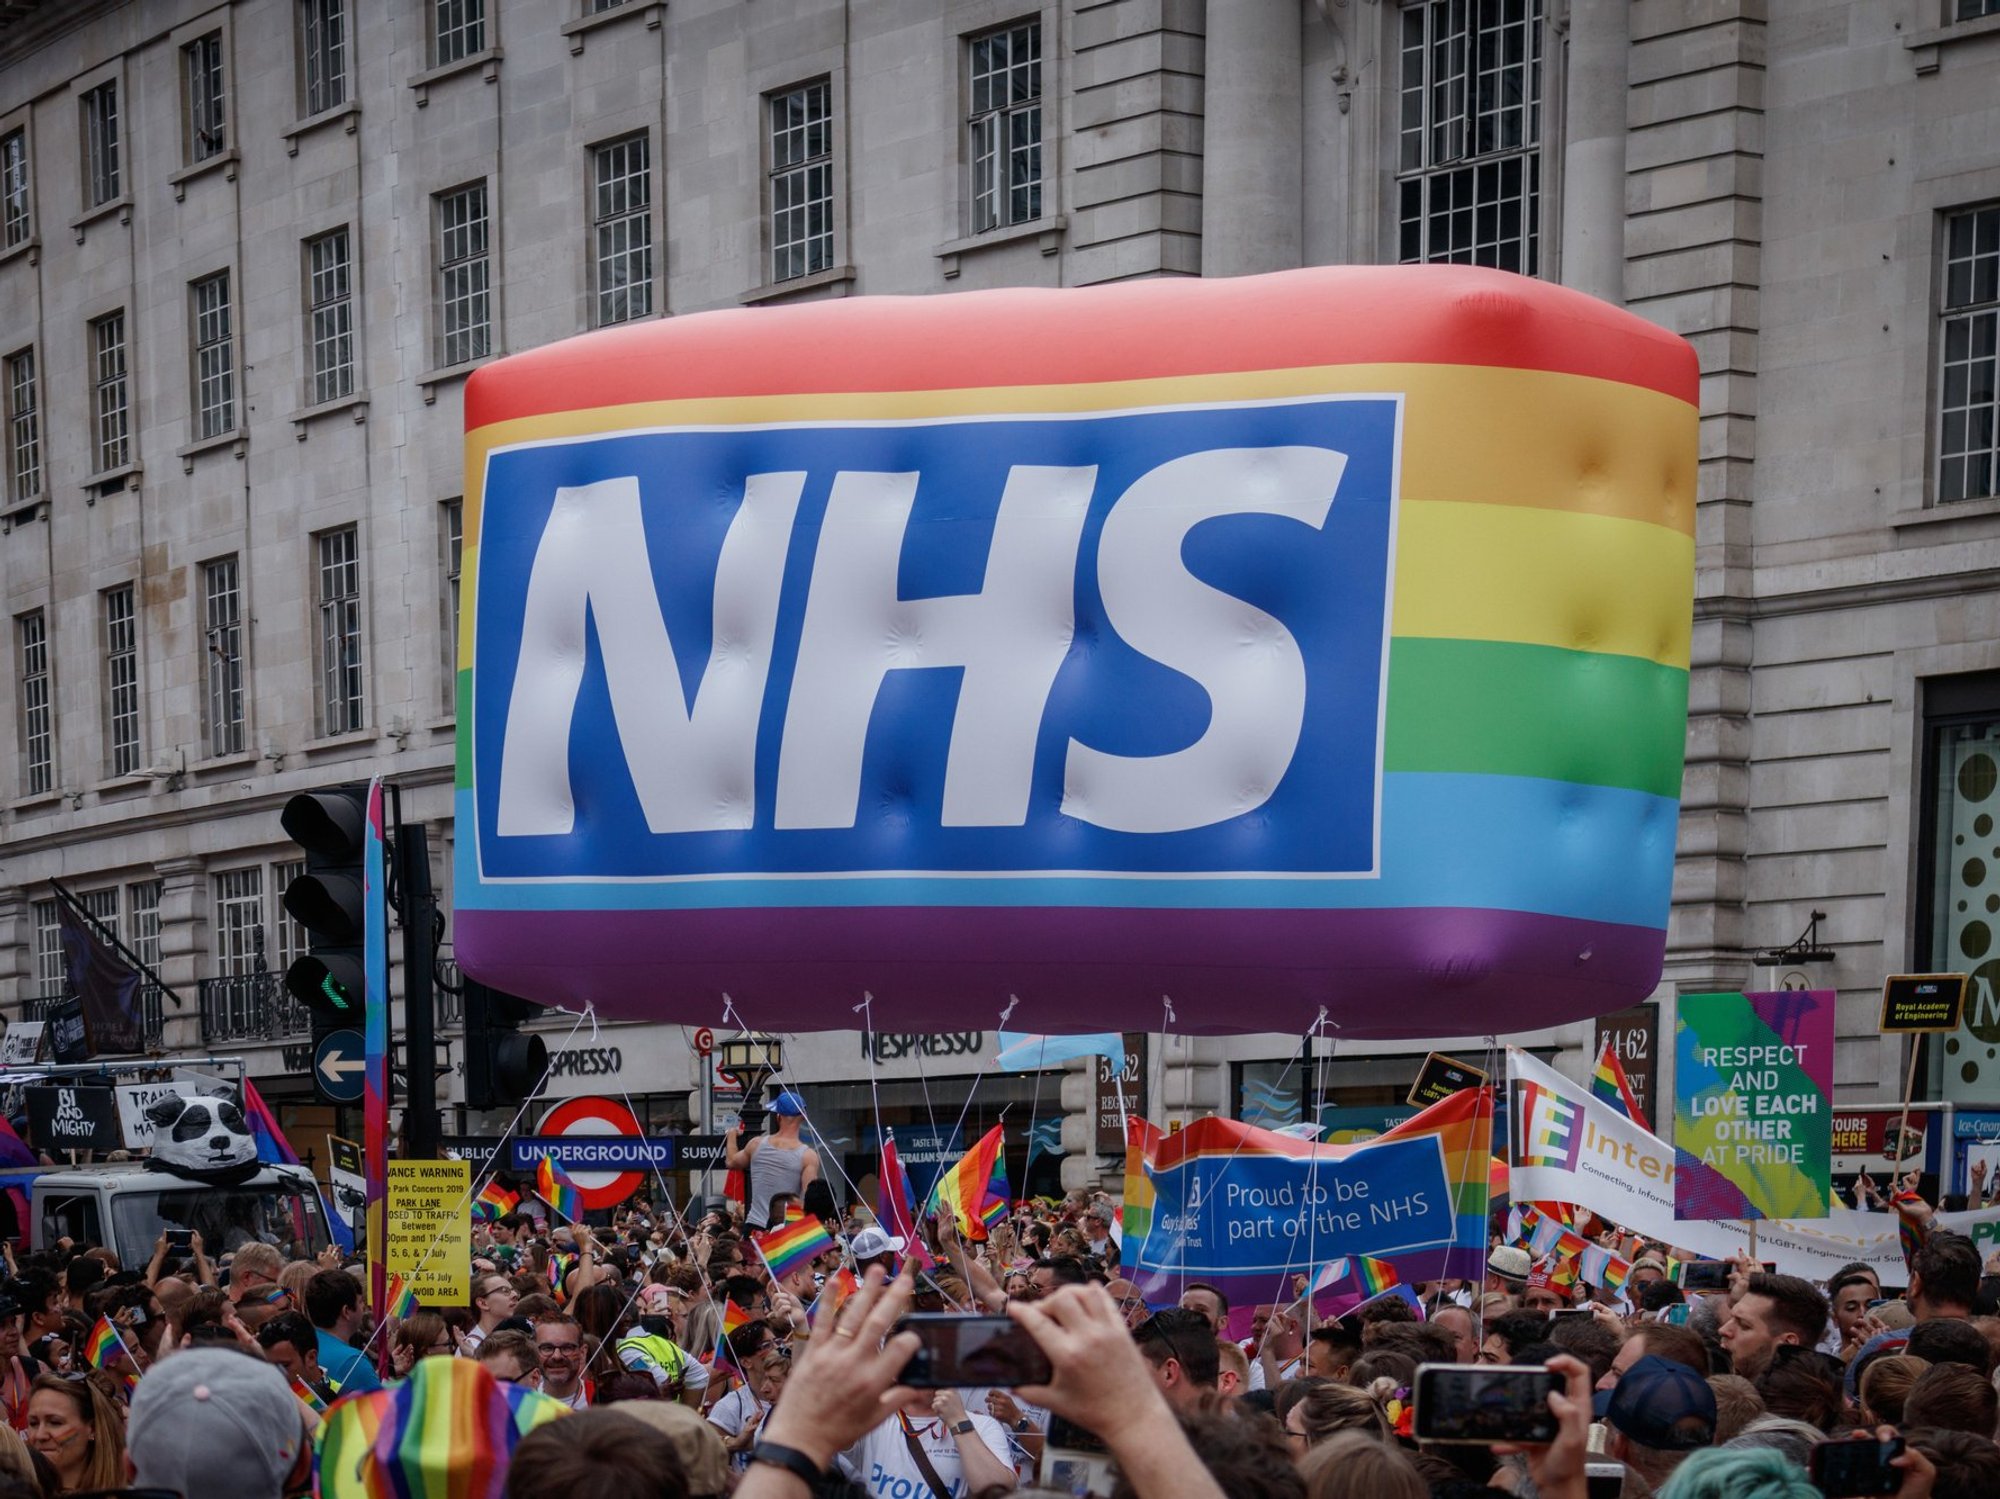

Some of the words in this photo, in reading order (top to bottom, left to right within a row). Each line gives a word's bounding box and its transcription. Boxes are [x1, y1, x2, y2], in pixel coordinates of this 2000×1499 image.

[498, 445, 1349, 836] NHS
[1895, 1003, 1916, 1012] Royal
[1917, 1003, 1950, 1012] Academy
[1895, 1012, 1902, 1020] of
[1904, 1011, 1948, 1021] Engineering
[1601, 1029, 1648, 1060] 4-62
[1703, 1045, 1808, 1067] RESPECT
[1100, 1054, 1139, 1084] 562
[1729, 1070, 1779, 1091] AND
[57, 1088, 76, 1107] BI
[1100, 1095, 1138, 1110] REGNT
[57, 1106, 83, 1120] AND
[1691, 1095, 1749, 1117] LOVE
[1755, 1094, 1818, 1115] EACH
[51, 1119, 96, 1137] MIGHTY
[1715, 1119, 1792, 1140] OTHER
[912, 1138, 931, 1147] TASTE
[1832, 1132, 1867, 1147] HERE
[518, 1145, 667, 1161] UNDERGROUND
[1700, 1145, 1731, 1166] AT
[1736, 1144, 1805, 1165] PRIDE
[419, 1167, 464, 1178] WARNING
[1582, 1162, 1635, 1193] Connecting,
[393, 1185, 410, 1193] Park
[412, 1185, 444, 1193] Concerts
[446, 1185, 464, 1193] 2019
[1227, 1181, 1295, 1207] Proud
[1301, 1184, 1328, 1205] to
[1335, 1178, 1370, 1201] be
[396, 1199, 417, 1208] PARK
[420, 1199, 441, 1208] LANE
[412, 1211, 423, 1220] TO
[426, 1211, 459, 1220] TRAFFIC
[1228, 1215, 1276, 1245] part
[1283, 1211, 1308, 1237] of
[1316, 1209, 1361, 1235] the
[1370, 1192, 1429, 1226] NHS
[401, 1222, 436, 1231] Between
[410, 1234, 426, 1243] and
[413, 1249, 420, 1258] &
[431, 1248, 446, 1260] July
[1769, 1237, 1803, 1252] LGBT+
[1807, 1246, 1858, 1261] Engineers
[415, 1272, 422, 1281] &
[426, 1273, 435, 1281] 14
[437, 1272, 452, 1284] July
[412, 1287, 435, 1297] AVOID
[437, 1287, 459, 1297] AREA
